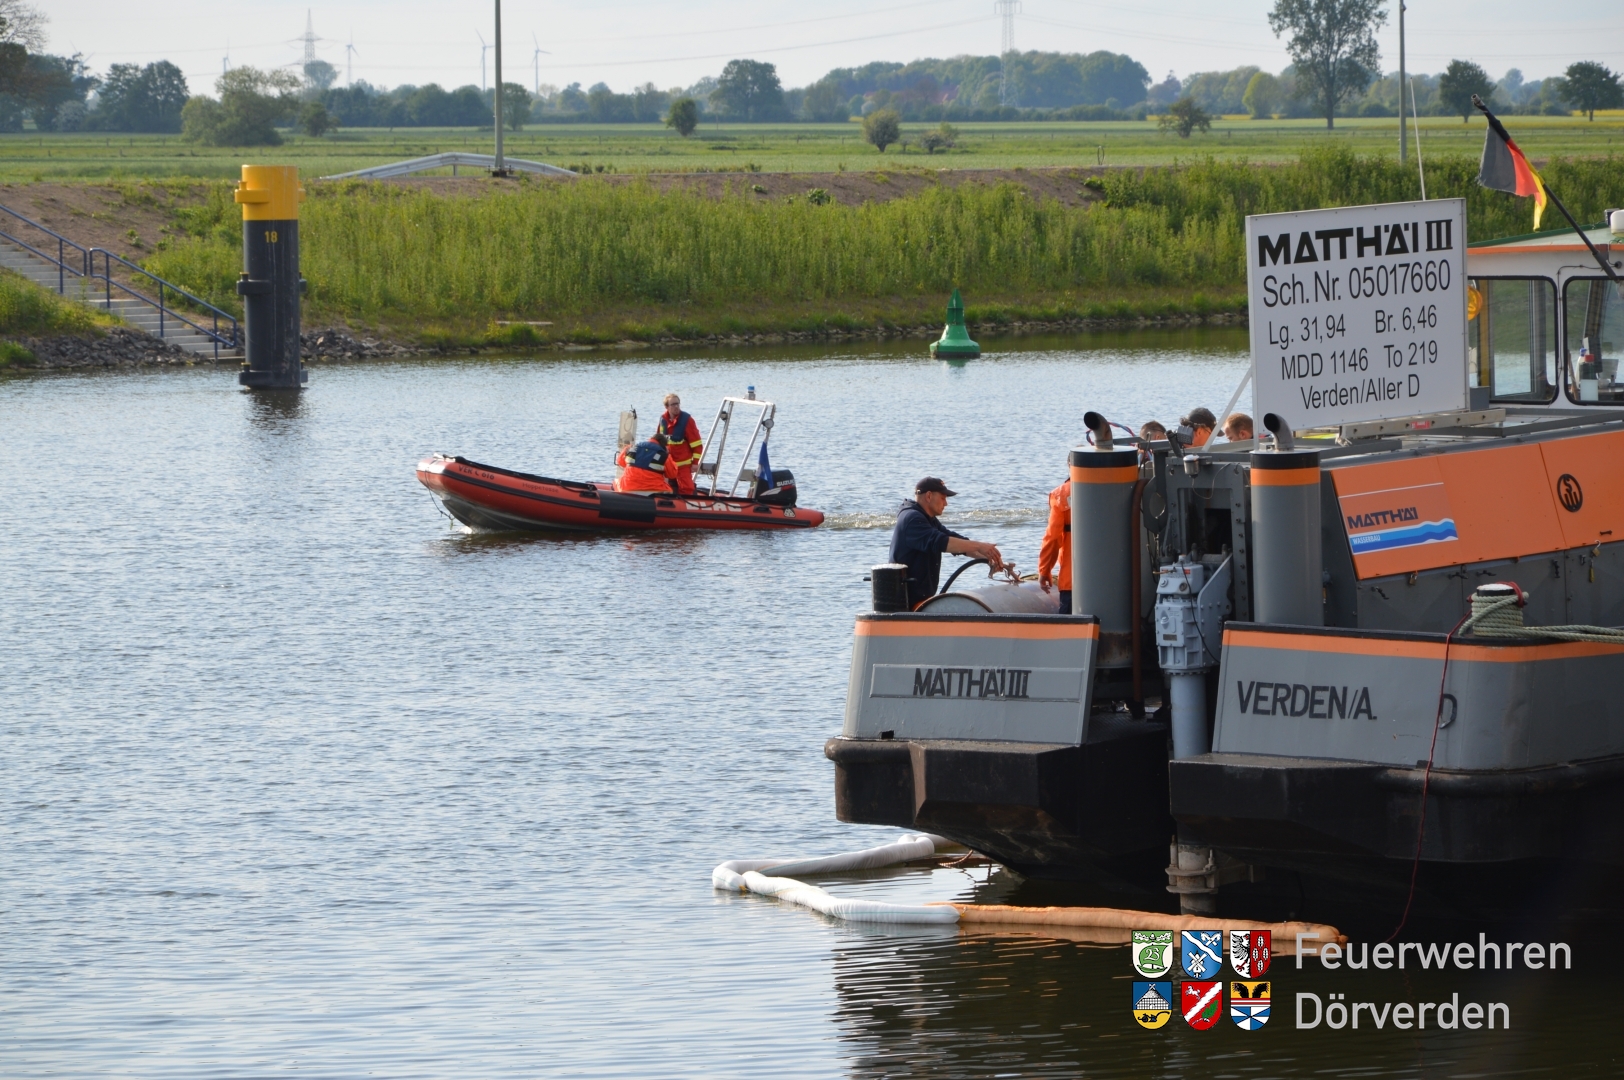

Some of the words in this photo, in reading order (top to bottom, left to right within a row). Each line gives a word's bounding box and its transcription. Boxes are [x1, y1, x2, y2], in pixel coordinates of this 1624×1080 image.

[265, 231, 278, 243] 18
[1258, 221, 1419, 267] MATTHÄI
[1425, 219, 1454, 252] III
[1263, 273, 1310, 308] Sch.
[1314, 270, 1342, 303] Nr.
[1348, 259, 1451, 299] 05017660
[1269, 320, 1294, 350] Lg.
[1300, 313, 1346, 343] 31,94
[1375, 309, 1396, 333] Br.
[1402, 304, 1438, 334] 6,46
[1281, 352, 1324, 380] MDD
[1330, 347, 1369, 374] 1146
[1383, 345, 1403, 368] To
[1408, 340, 1438, 366] 219
[1300, 377, 1403, 410] Verden/Aller
[1408, 373, 1421, 398] D
[1347, 506, 1419, 530] MATTHÄI
[1352, 534, 1381, 545] WASSERBAU
[1237, 680, 1378, 720] VERDEN/A.
